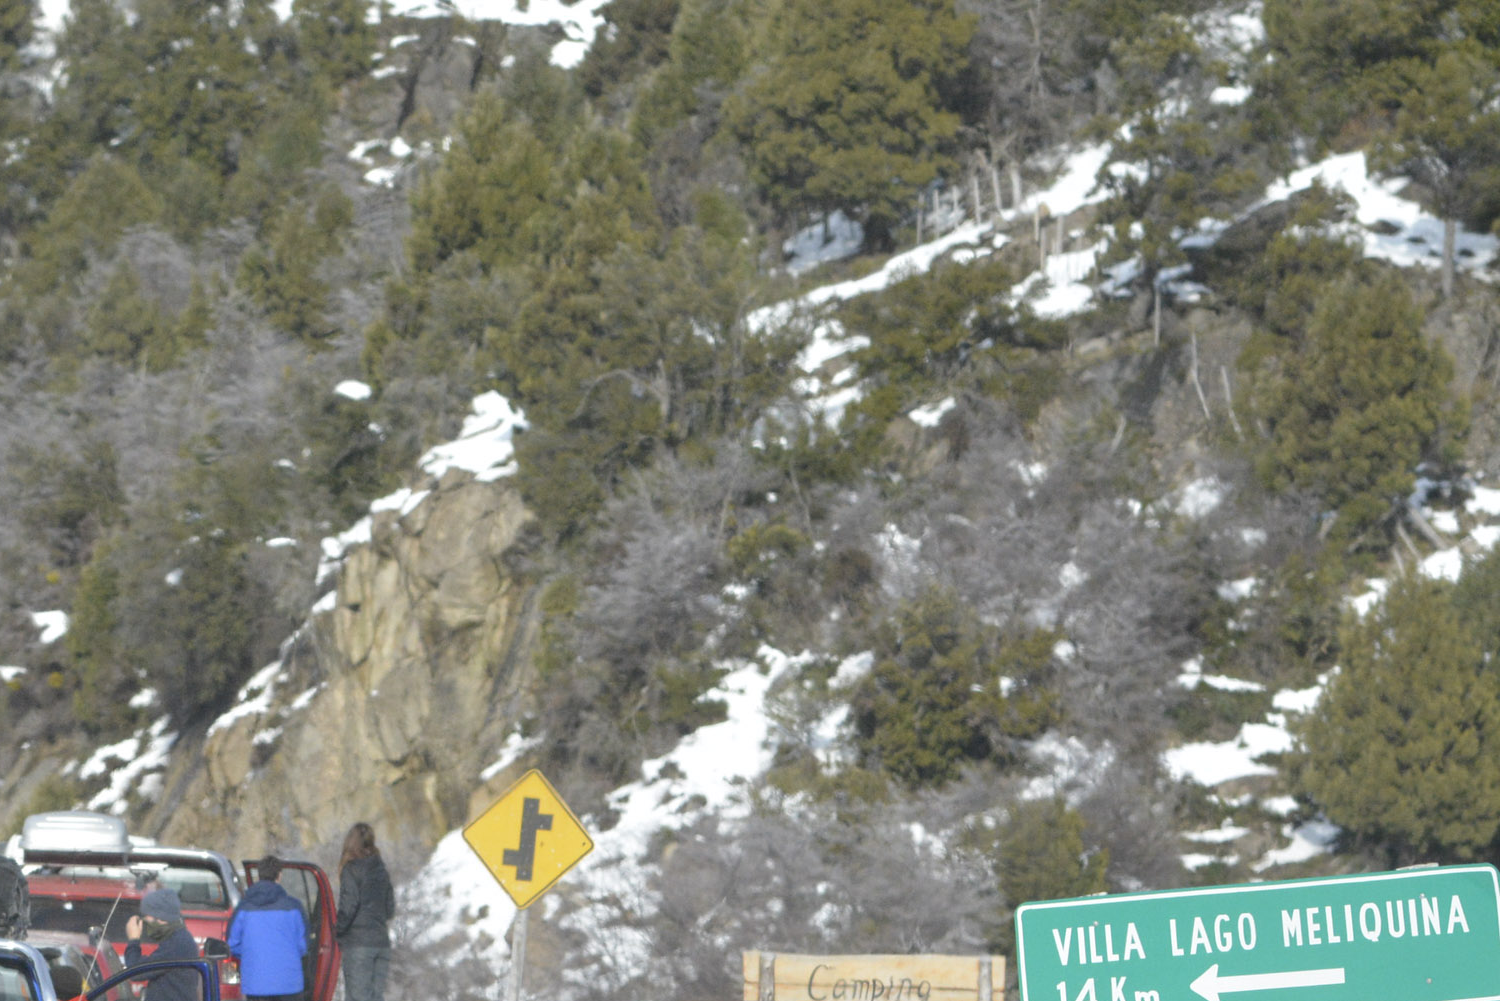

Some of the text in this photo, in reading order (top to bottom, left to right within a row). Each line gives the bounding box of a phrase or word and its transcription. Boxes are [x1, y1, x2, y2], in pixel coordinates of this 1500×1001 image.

[1051, 893, 1471, 967] VILLA LAGO MELIQUINA
